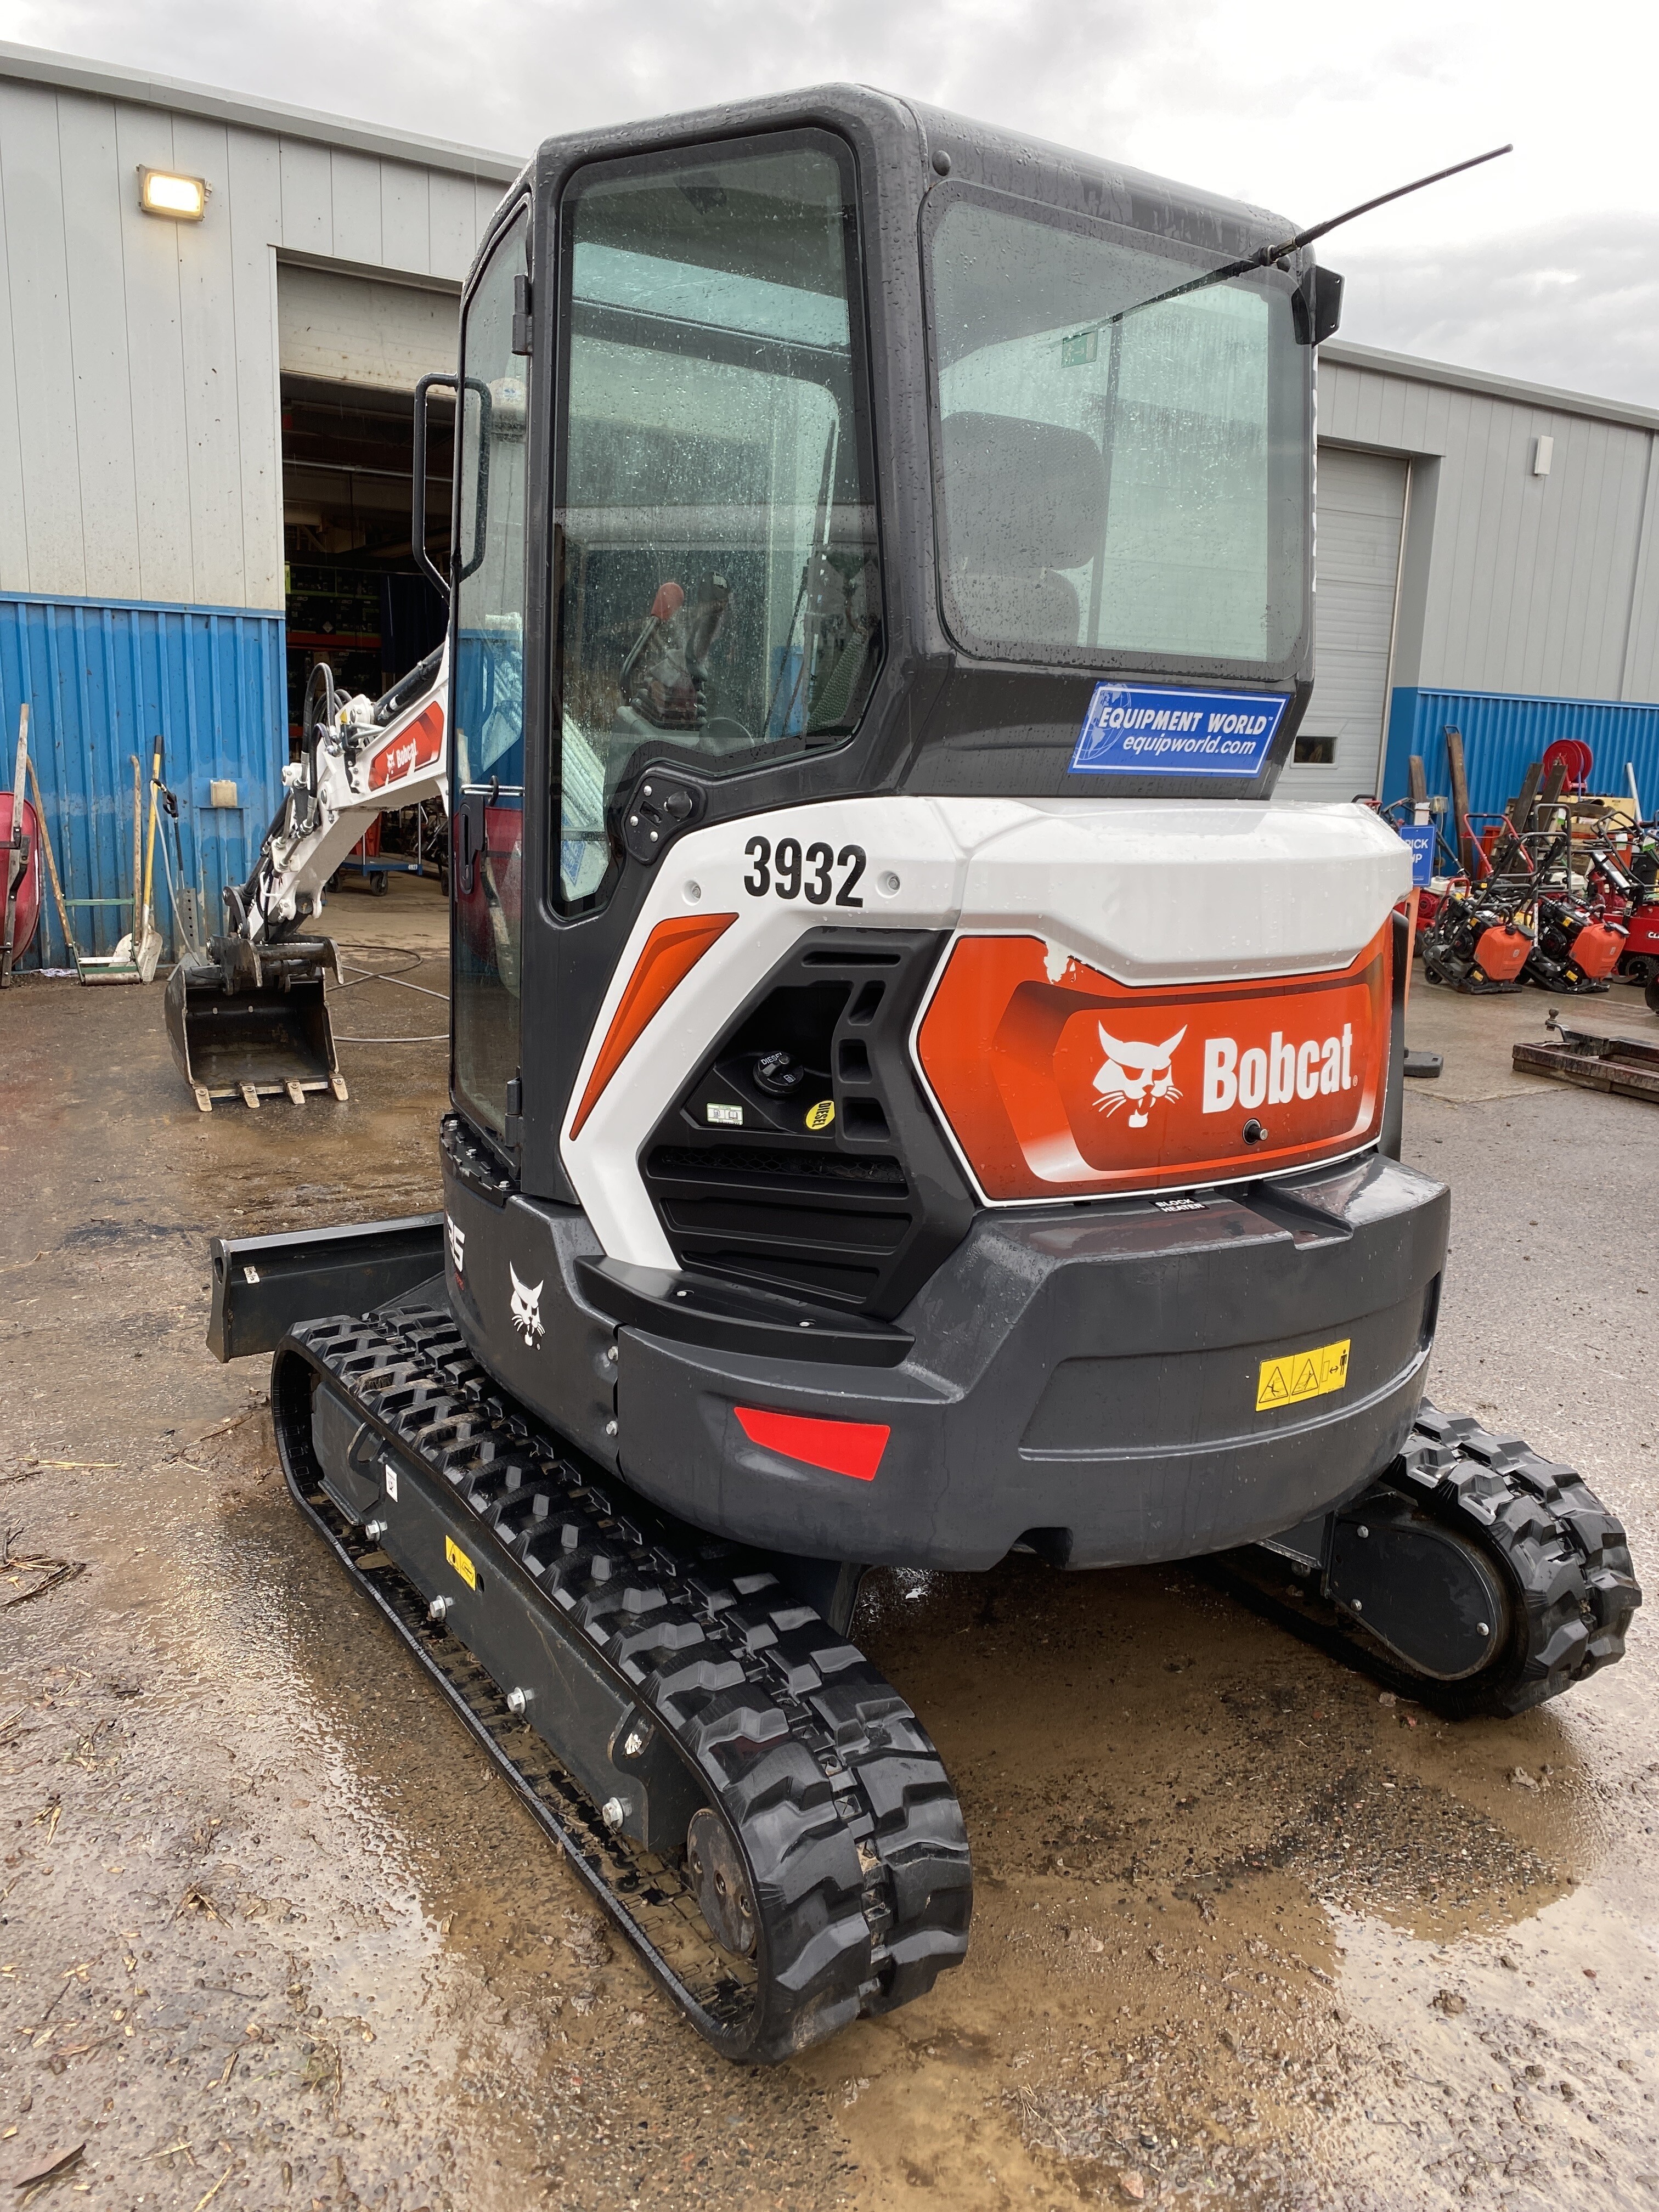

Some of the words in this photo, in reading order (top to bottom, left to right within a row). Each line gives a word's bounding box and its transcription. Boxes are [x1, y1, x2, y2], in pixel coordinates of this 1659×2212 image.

[1098, 707, 1204, 732] EQUIPMENT
[1207, 713, 1267, 735] WORLD
[396, 738, 417, 769] Bobcat
[1123, 733, 1257, 756] equipworld.com
[744, 836, 867, 908] 3932
[1203, 1023, 1353, 1114] Bobcat
[811, 1102, 832, 1128] DIESEL
[1155, 1199, 1195, 1207] BLOCK
[1160, 1203, 1205, 1212] HEATER
